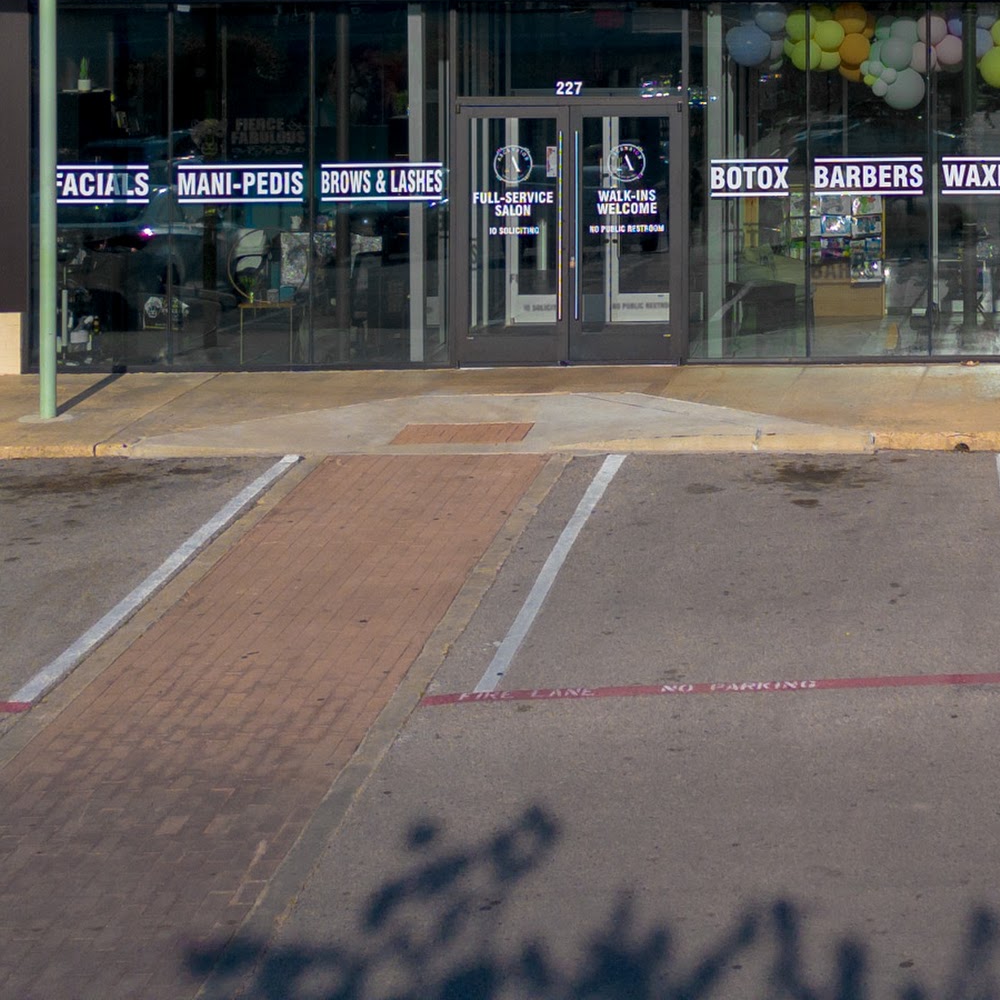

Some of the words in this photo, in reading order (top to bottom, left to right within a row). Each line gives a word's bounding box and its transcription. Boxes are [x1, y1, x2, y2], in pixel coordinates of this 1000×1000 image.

[556, 81, 583, 95] 227
[235, 117, 285, 131] FIERCE
[231, 131, 306, 145] FABULOUS
[321, 170, 371, 193] BROWS
[375, 169, 387, 193] &
[390, 169, 443, 193] LASHES
[711, 165, 789, 189] BOTOX
[814, 164, 923, 188] BARBERS
[178, 171, 303, 196] MANI-PEDIS
[472, 191, 554, 204] FULL-SERVICE
[598, 190, 656, 202] WALK-INS
[495, 204, 531, 217] SALON
[597, 202, 658, 215] WELCOME
[499, 226, 540, 235] SOLICITING
[589, 225, 600, 233] NO
[601, 225, 626, 233] PUBLIC
[627, 224, 665, 233] RESTROOM
[459, 690, 516, 701] FIRE
[530, 687, 596, 698] LANE
[660, 683, 694, 693] NO
[710, 680, 817, 692] PARKING
